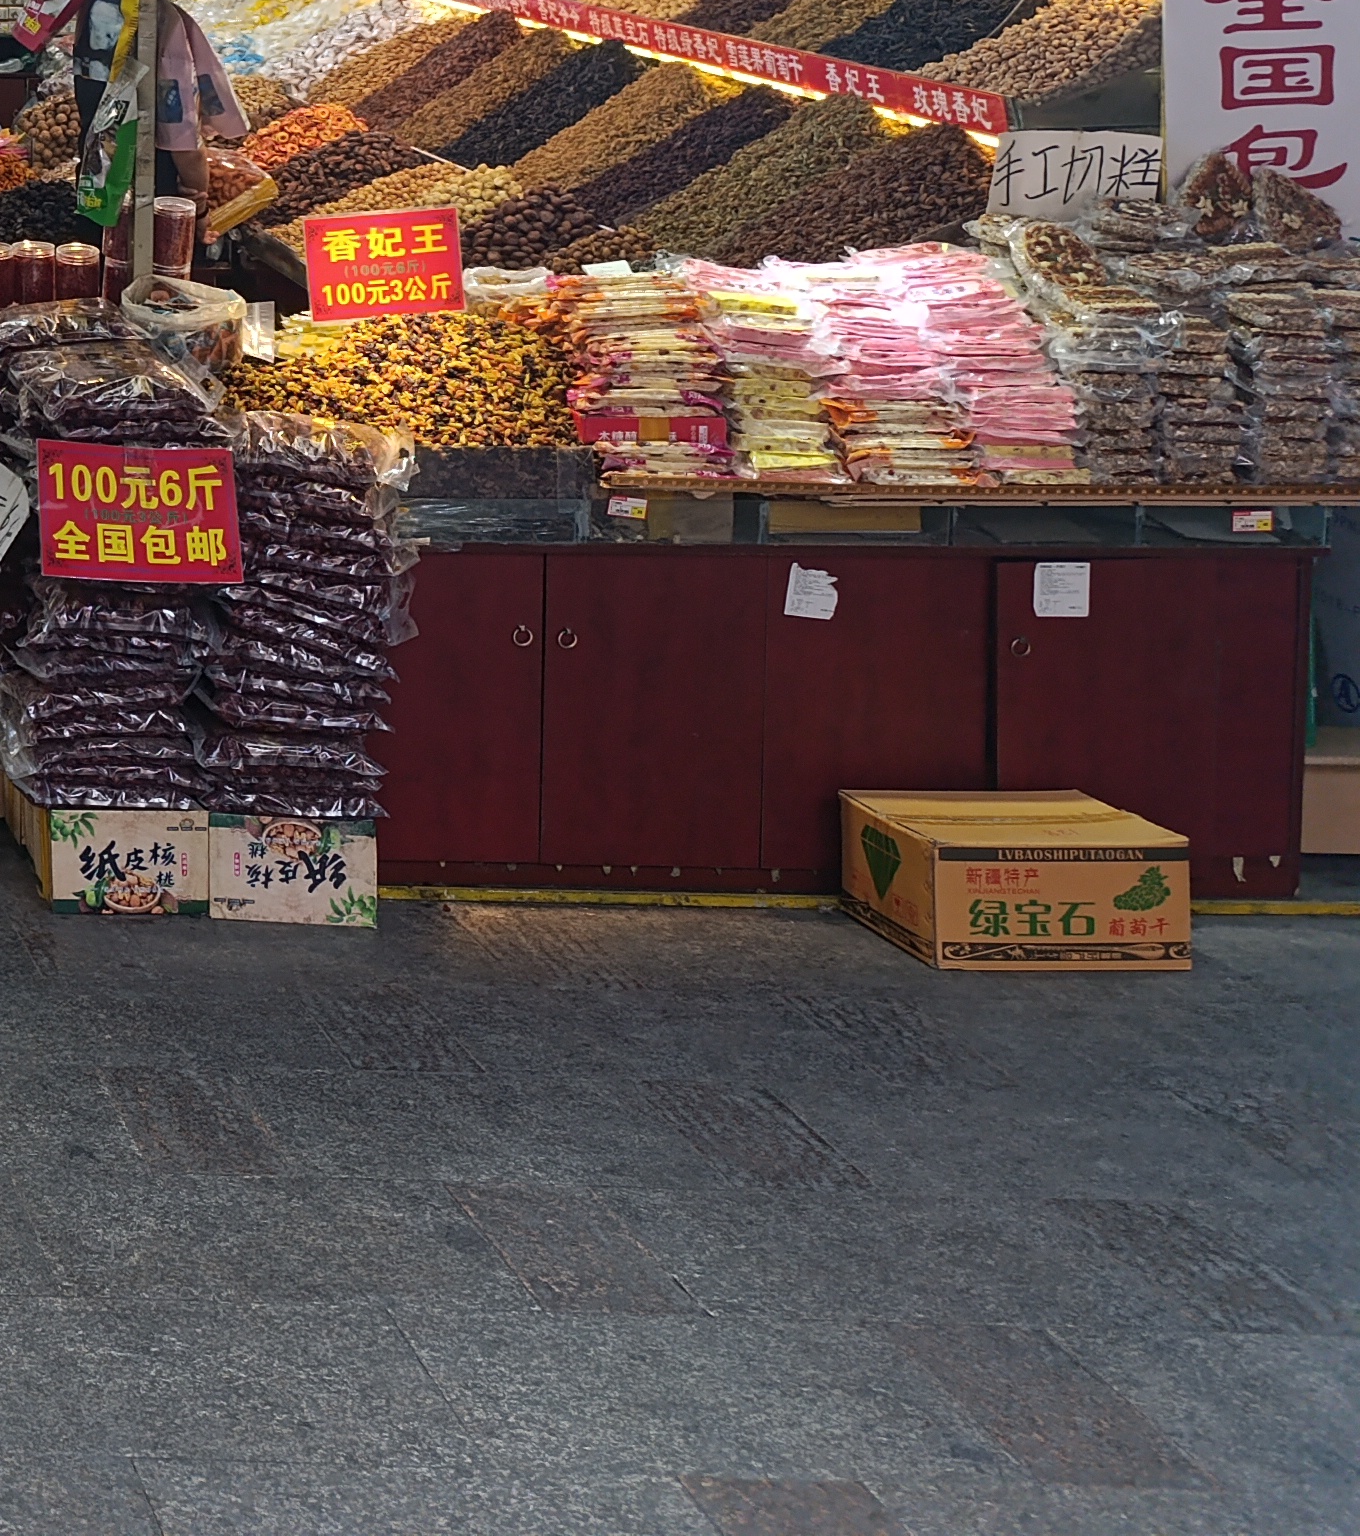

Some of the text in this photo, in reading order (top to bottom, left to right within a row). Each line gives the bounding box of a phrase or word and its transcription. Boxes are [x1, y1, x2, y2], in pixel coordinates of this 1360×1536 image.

[826, 63, 885, 104] 香妃王
[913, 84, 992, 131] 玫瑰香妃
[323, 224, 448, 261] 香妃王
[321, 271, 452, 307] 100元3公斤
[48, 464, 223, 512] 100元6斤
[53, 520, 229, 567] 全国包邮
[79, 840, 177, 888] 纸皮核桃
[245, 842, 347, 893] 纸皮核桃
[998, 849, 1144, 861] LVBAOSHIPUTAOGAN
[966, 866, 1040, 887] 新疆特产
[968, 898, 1096, 938] 绿宝石
[1108, 917, 1171, 939] 葡萄干
